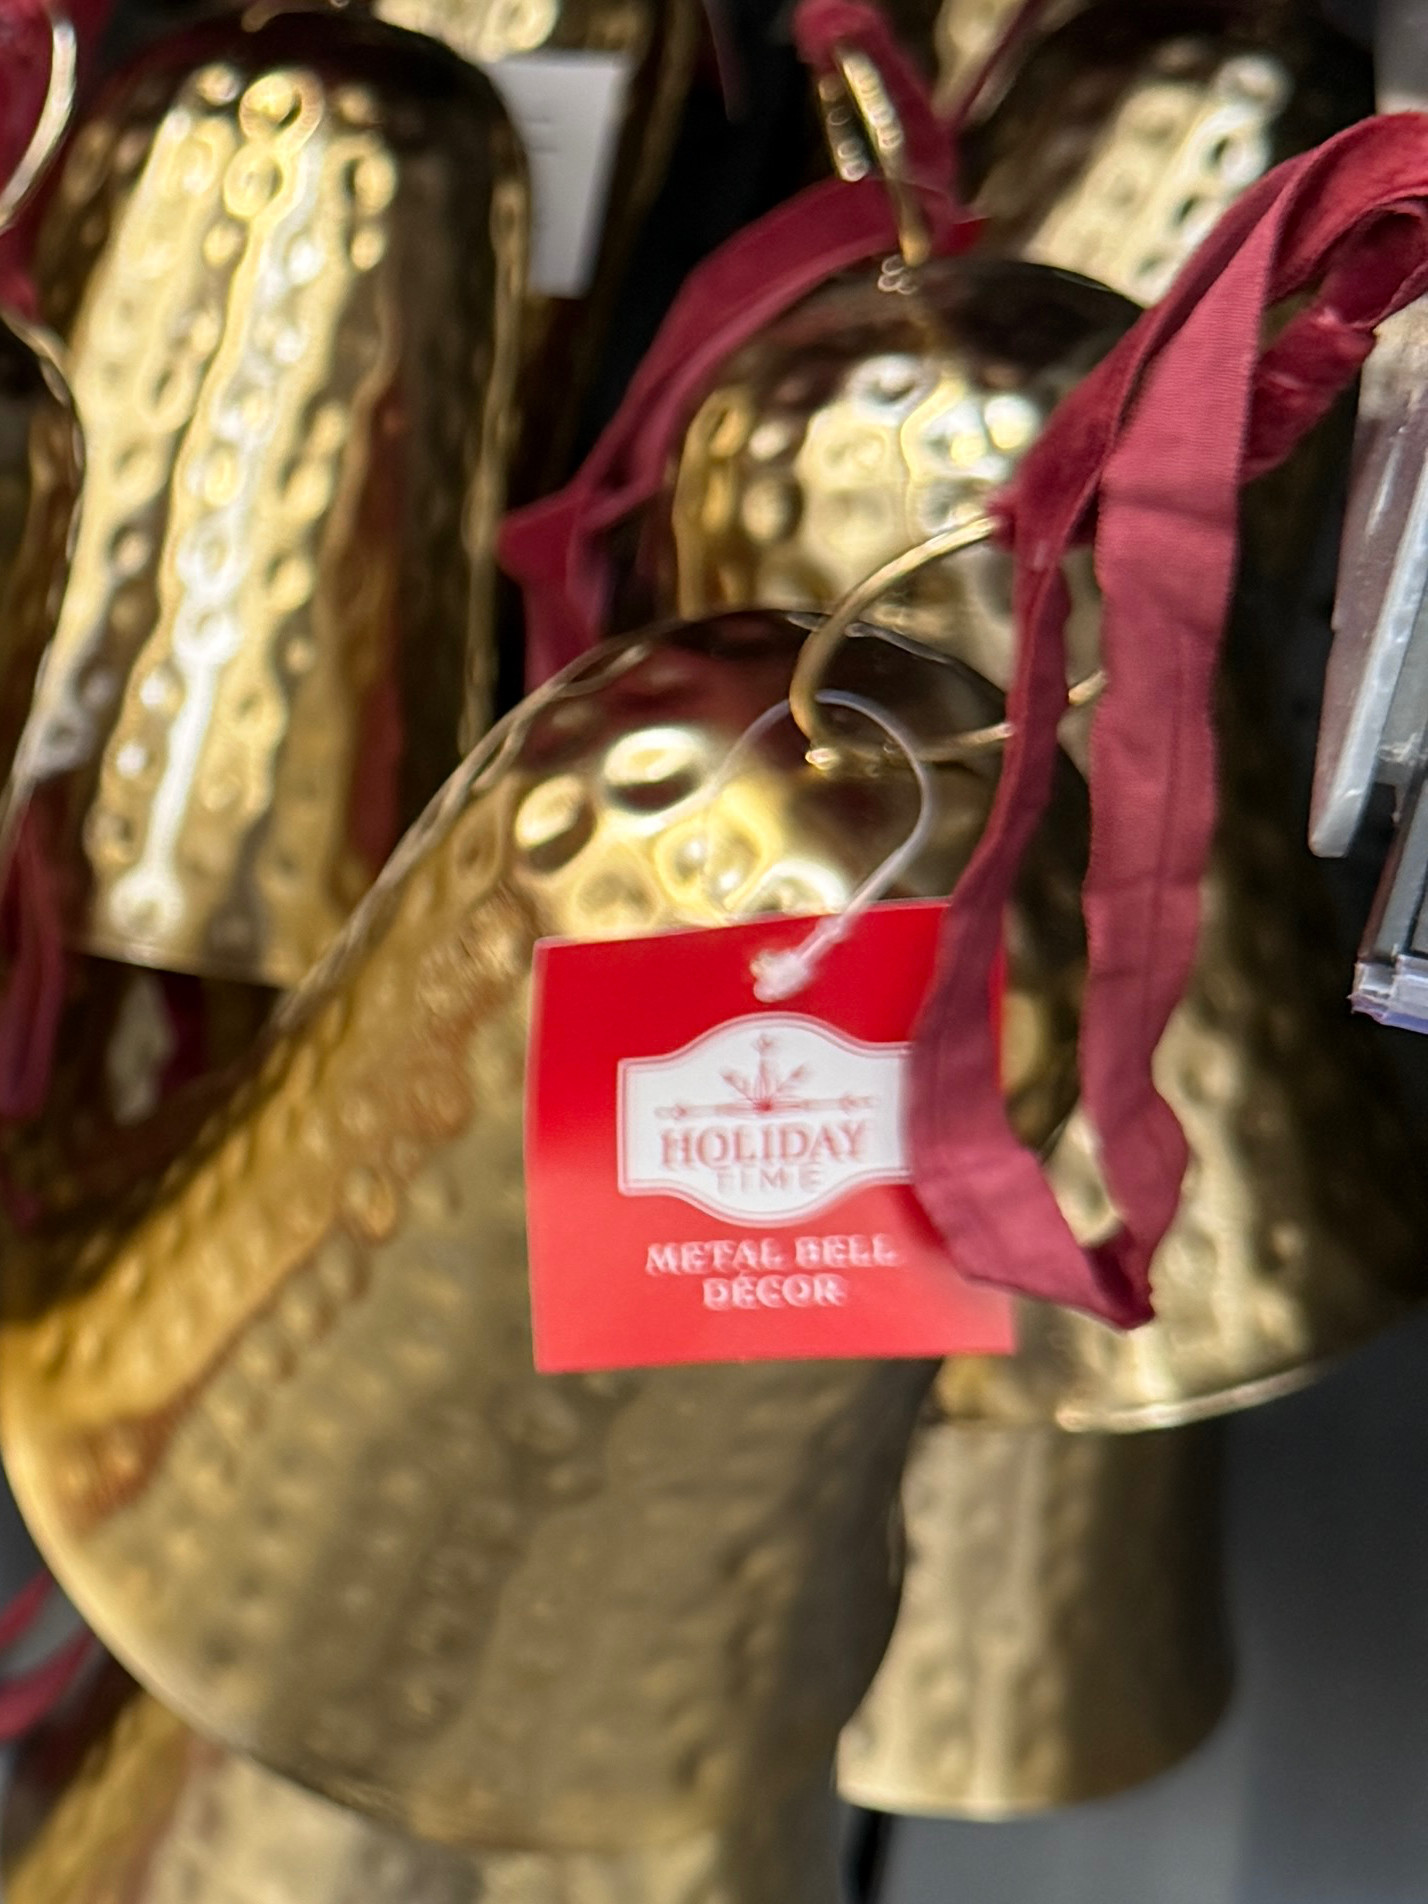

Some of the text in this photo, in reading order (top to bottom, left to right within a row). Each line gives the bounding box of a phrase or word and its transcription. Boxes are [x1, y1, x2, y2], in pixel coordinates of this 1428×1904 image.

[659, 1118, 868, 1172] HOLIDAY
[715, 1162, 823, 1195] TIME
[645, 1233, 904, 1277] METAL BELL
[702, 1270, 850, 1311] DÉCOR
